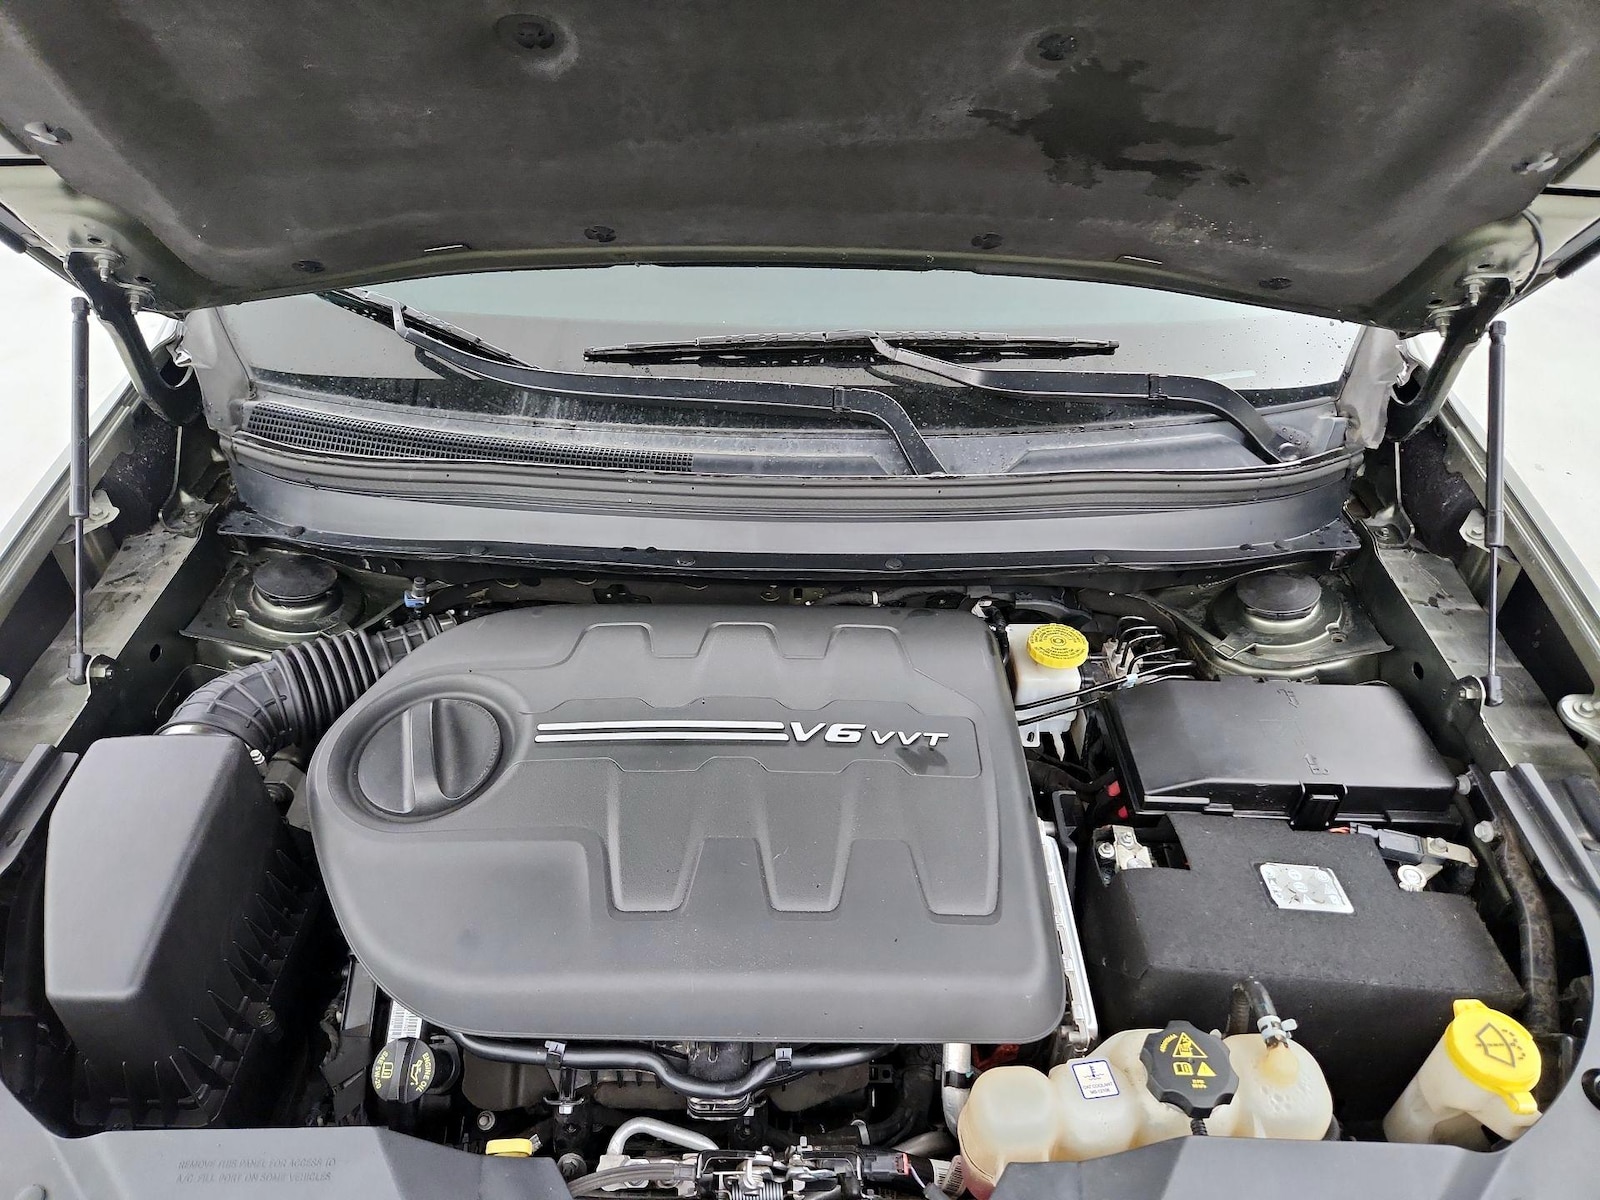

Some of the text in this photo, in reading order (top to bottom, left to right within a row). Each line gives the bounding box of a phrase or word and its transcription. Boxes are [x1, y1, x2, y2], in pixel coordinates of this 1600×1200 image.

[790, 721, 949, 747] V6 VVT
[374, 1051, 389, 1089] SAE 5W-20
[416, 1052, 432, 1092] ENGINE OIL
[178, 1158, 336, 1169] REMOVE THIS PANEL FOR ACCESS TO
[197, 1173, 215, 1183] FILL
[218, 1173, 241, 1183] PORT
[244, 1173, 259, 1182] ON
[260, 1172, 286, 1182] SOME
[289, 1171, 331, 1182] VEHICLES
